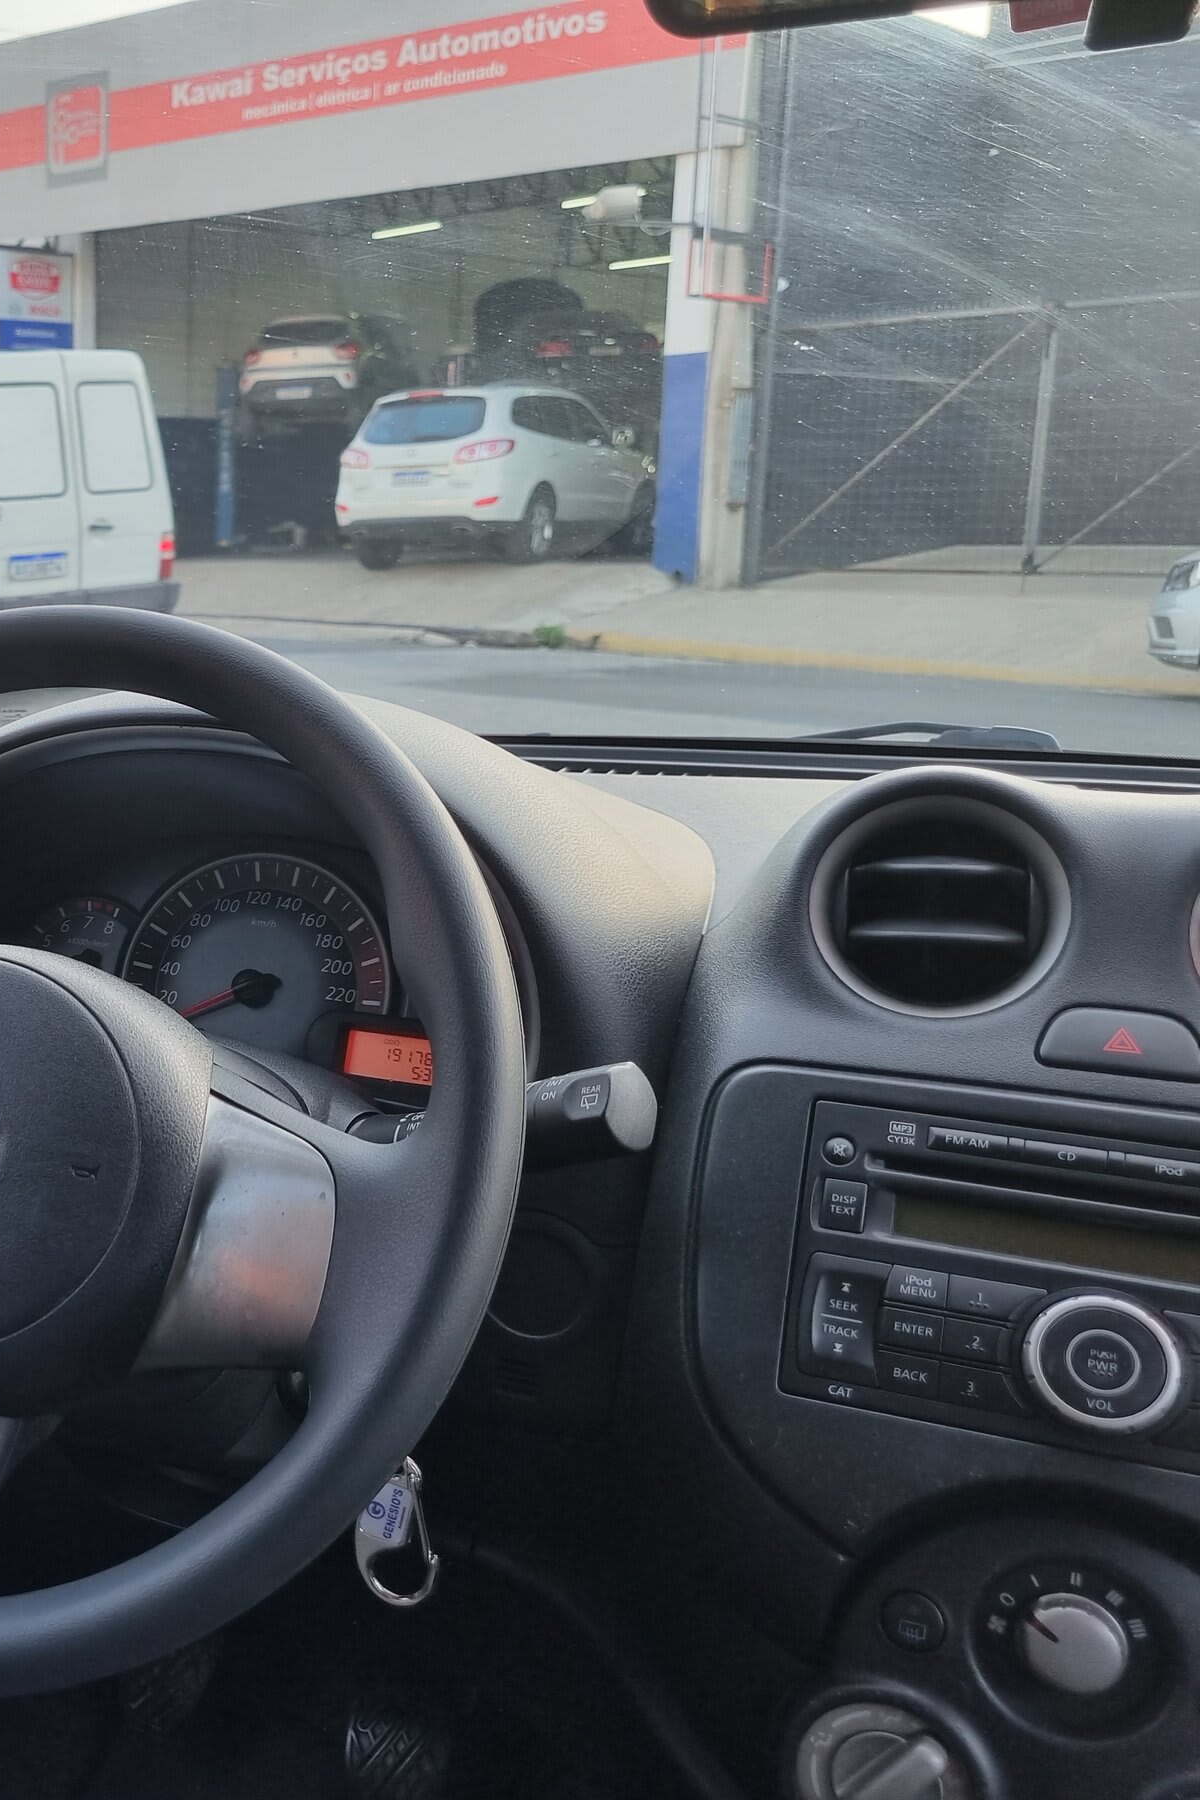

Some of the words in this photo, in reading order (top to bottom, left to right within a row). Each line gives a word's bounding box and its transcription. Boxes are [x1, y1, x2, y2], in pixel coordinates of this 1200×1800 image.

[171, 68, 253, 108] Kawai
[261, 49, 388, 92] Serviços
[396, 8, 608, 68] Automotivos
[403, 61, 509, 93] condicionado
[246, 890, 271, 905] 120
[275, 896, 302, 912] 140
[214, 898, 240, 913] 100
[60, 919, 71, 933] 6
[83, 915, 94, 929] 7
[103, 920, 115, 935] 8
[190, 913, 211, 928] 80
[251, 918, 277, 929] km/h
[299, 912, 327, 929] 160
[171, 934, 192, 949] 60
[315, 933, 344, 950] 180
[160, 961, 180, 976] 40
[320, 958, 353, 976] 200
[160, 990, 178, 1005] 20
[325, 986, 356, 1004] 220
[547, 1078, 565, 1088] INT
[581, 1084, 601, 1095] REAR
[541, 1090, 556, 1101] ON
[892, 1123, 913, 1134] MP3
[887, 1135, 915, 1146] CY13K
[1057, 1151, 1076, 1162] CD
[1154, 1163, 1184, 1177] iPod
[831, 1193, 857, 1204] DISP
[830, 1204, 856, 1216] TEXT
[905, 1274, 932, 1287] iPod
[899, 1284, 937, 1299] MENU
[829, 1298, 858, 1313] SEEK
[822, 1323, 858, 1339] TRACK
[894, 1321, 933, 1337] ENTER
[1090, 1348, 1117, 1360] PUSH
[1087, 1359, 1118, 1373] PWR
[893, 1367, 928, 1383] BACK
[828, 1384, 853, 1398] CAT
[1086, 1397, 1116, 1413] VOL
[382, 1488, 404, 1539] GENESIO'S
